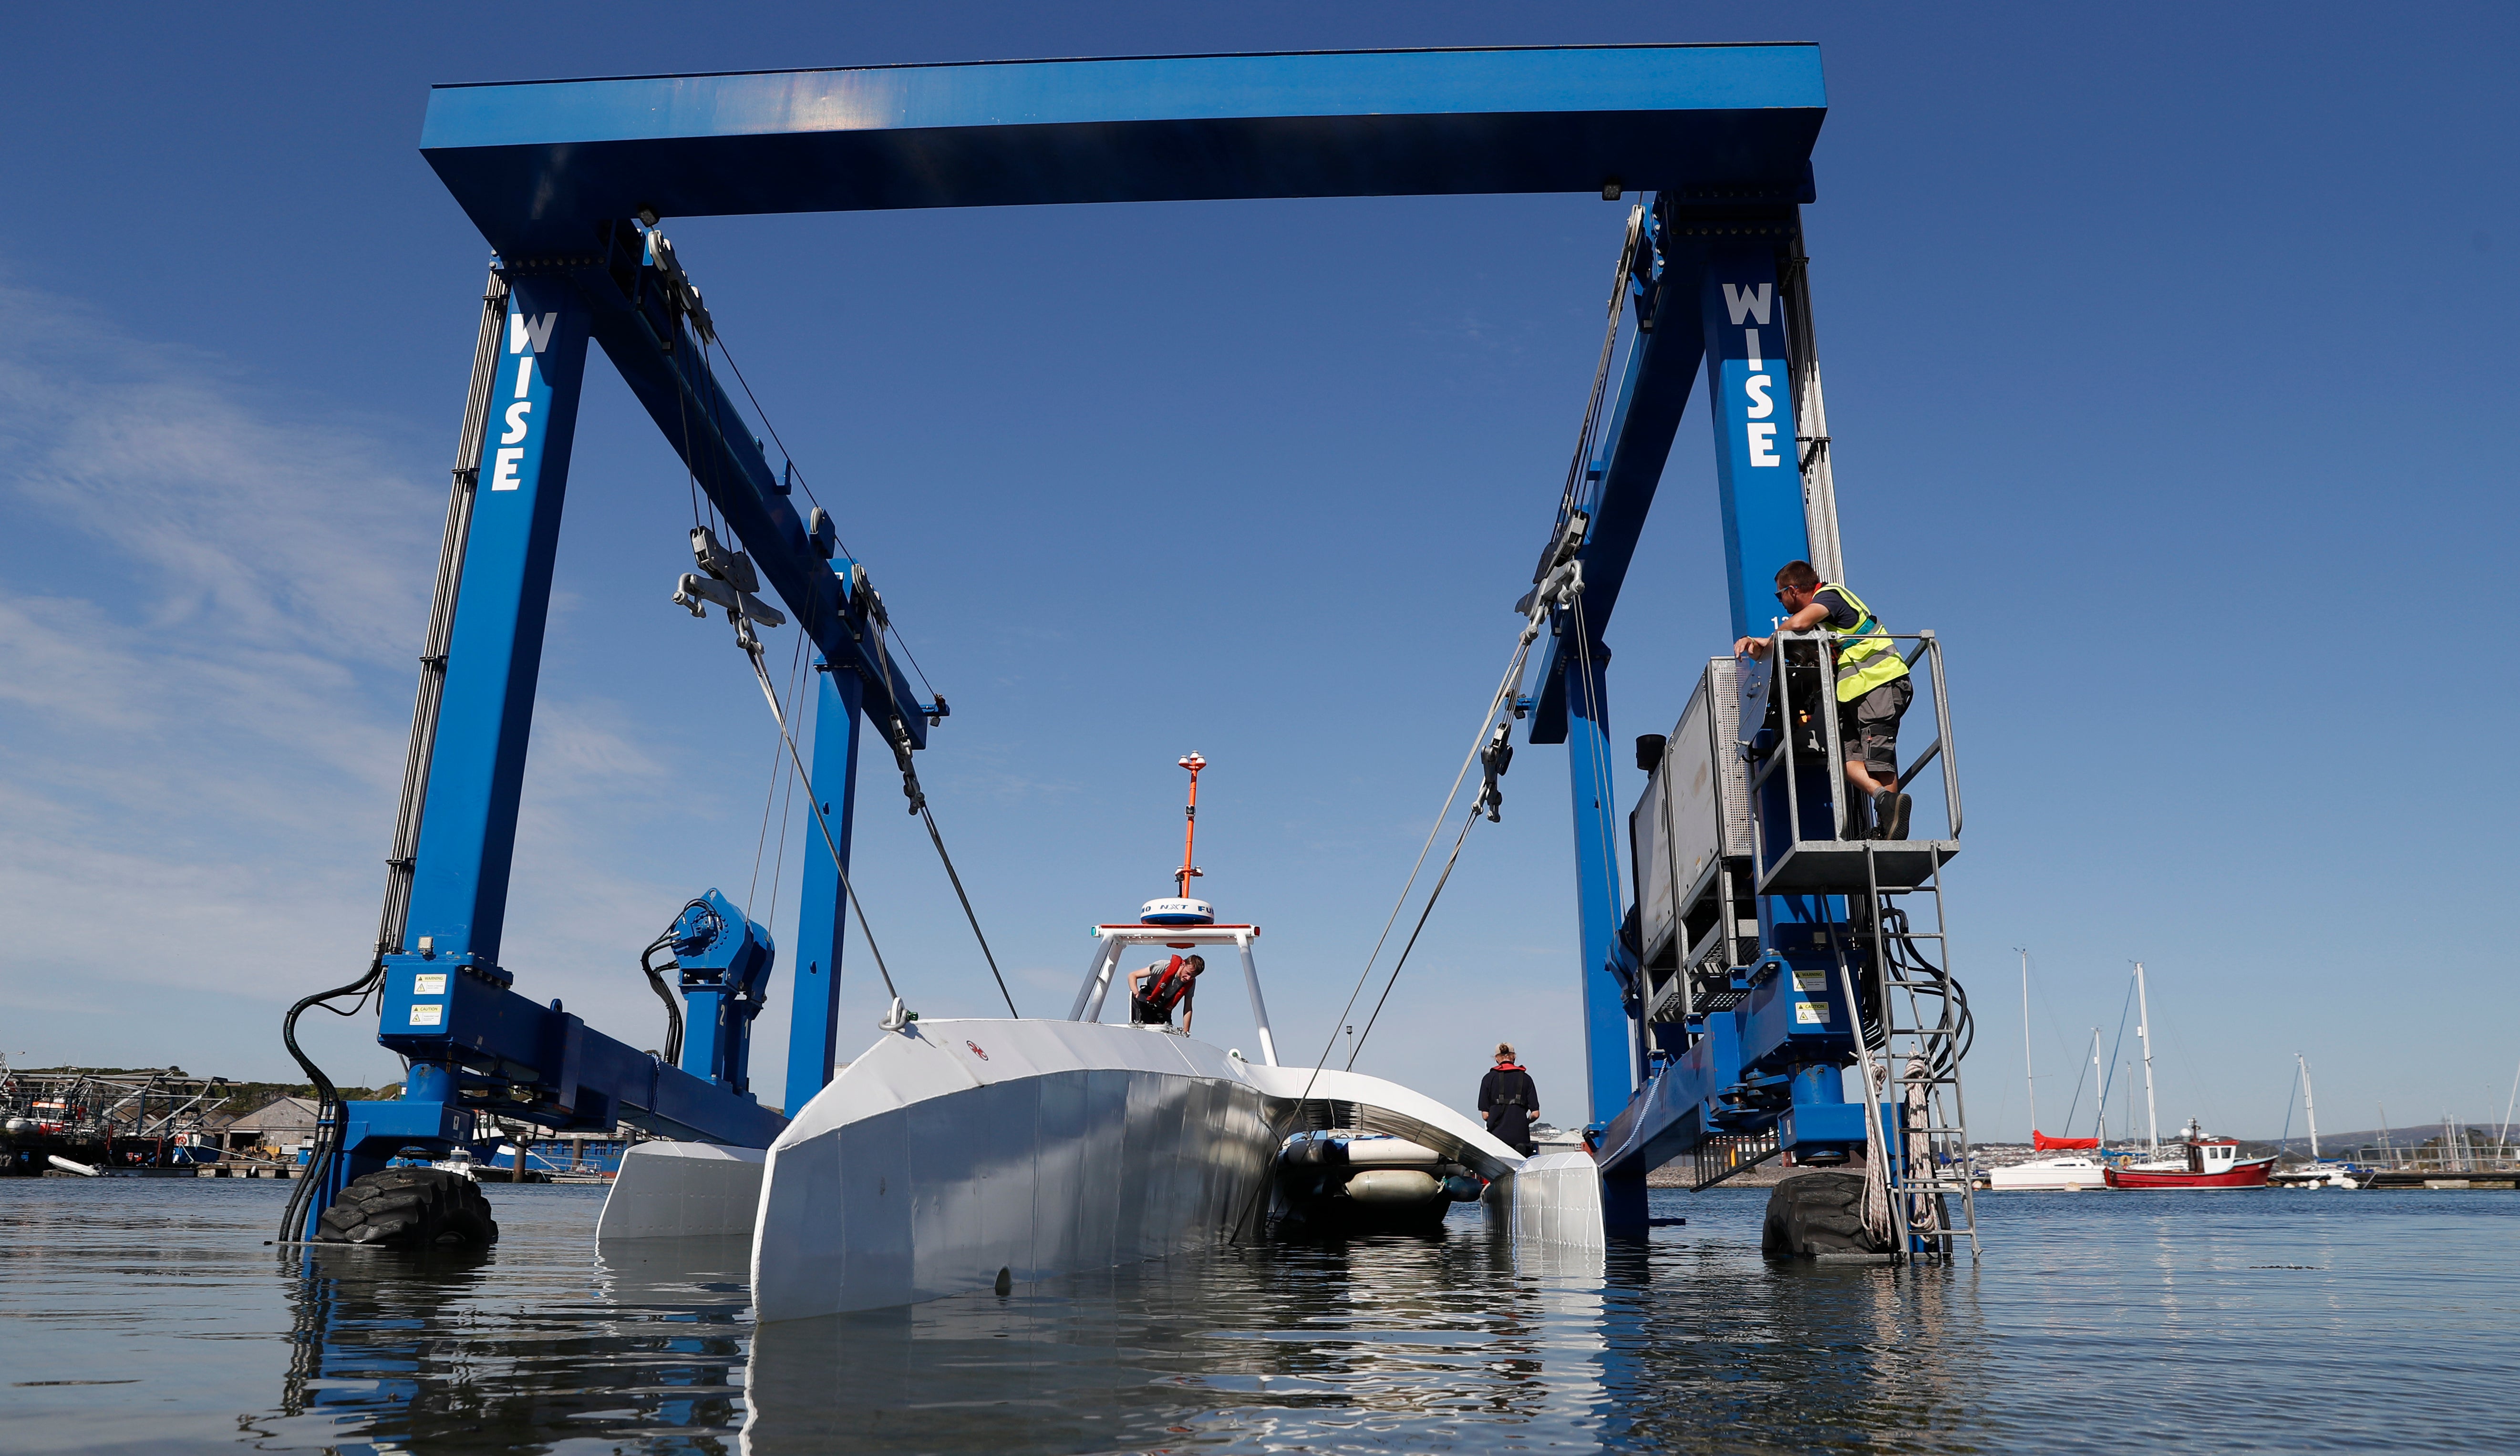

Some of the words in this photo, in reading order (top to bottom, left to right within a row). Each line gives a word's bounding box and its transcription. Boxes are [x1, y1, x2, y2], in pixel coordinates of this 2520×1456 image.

[491, 312, 558, 491] WISE
[1722, 283, 1781, 467] WISE
[719, 1004, 725, 1026] 2
